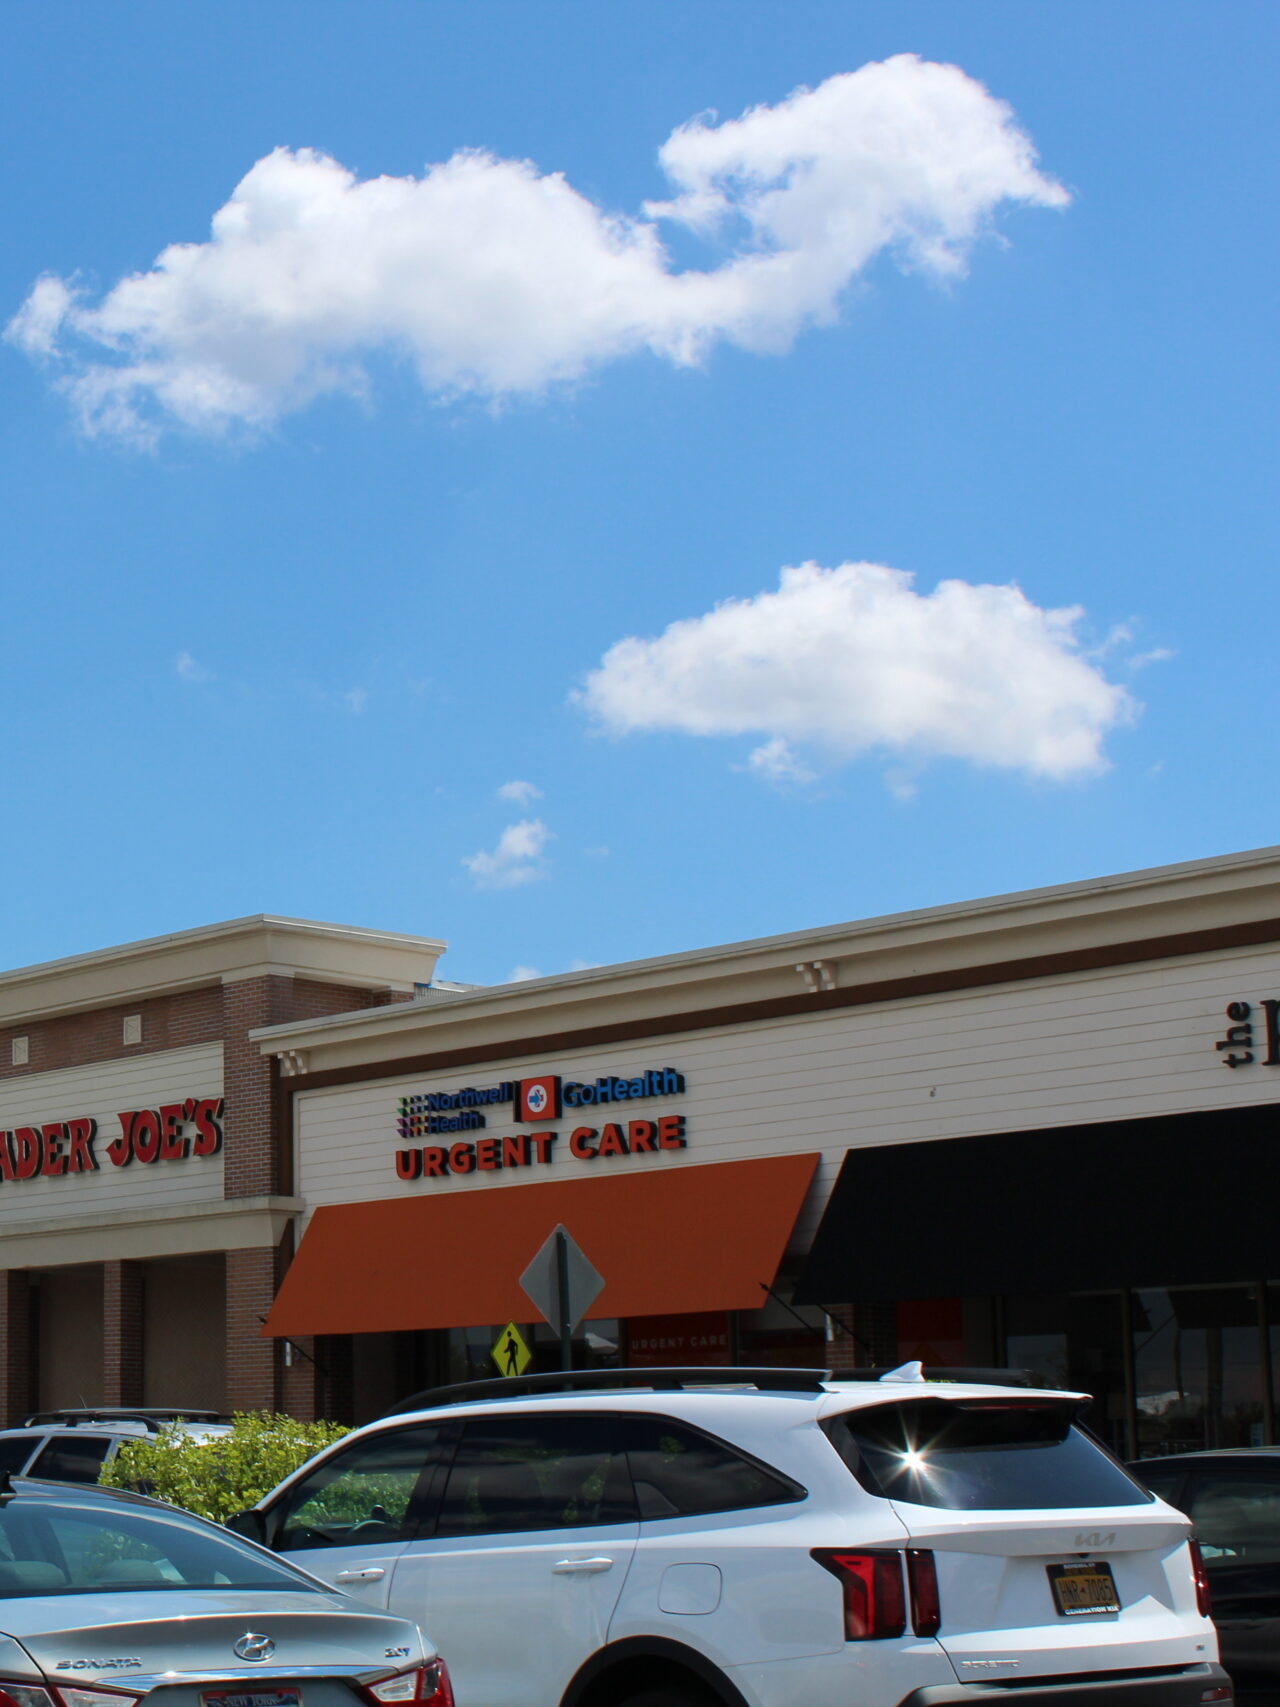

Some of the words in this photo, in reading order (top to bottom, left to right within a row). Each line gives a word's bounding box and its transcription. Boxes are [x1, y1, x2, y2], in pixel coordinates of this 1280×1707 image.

[1216, 1001, 1254, 1068] the
[427, 1079, 515, 1113] Northwell
[562, 1067, 686, 1108] GoHealth
[105, 1098, 225, 1167] JOE'S
[428, 1110, 486, 1135] Health
[395, 1131, 558, 1180] URGENT
[570, 1115, 687, 1160] CARE
[631, 1337, 686, 1350] URGENT
[690, 1335, 728, 1346] CARE
[1074, 1532, 1116, 1547] KIA
[56, 1657, 143, 1670] SONATA
[227, 1695, 249, 1706] NEW
[252, 1694, 278, 1705] YORK
